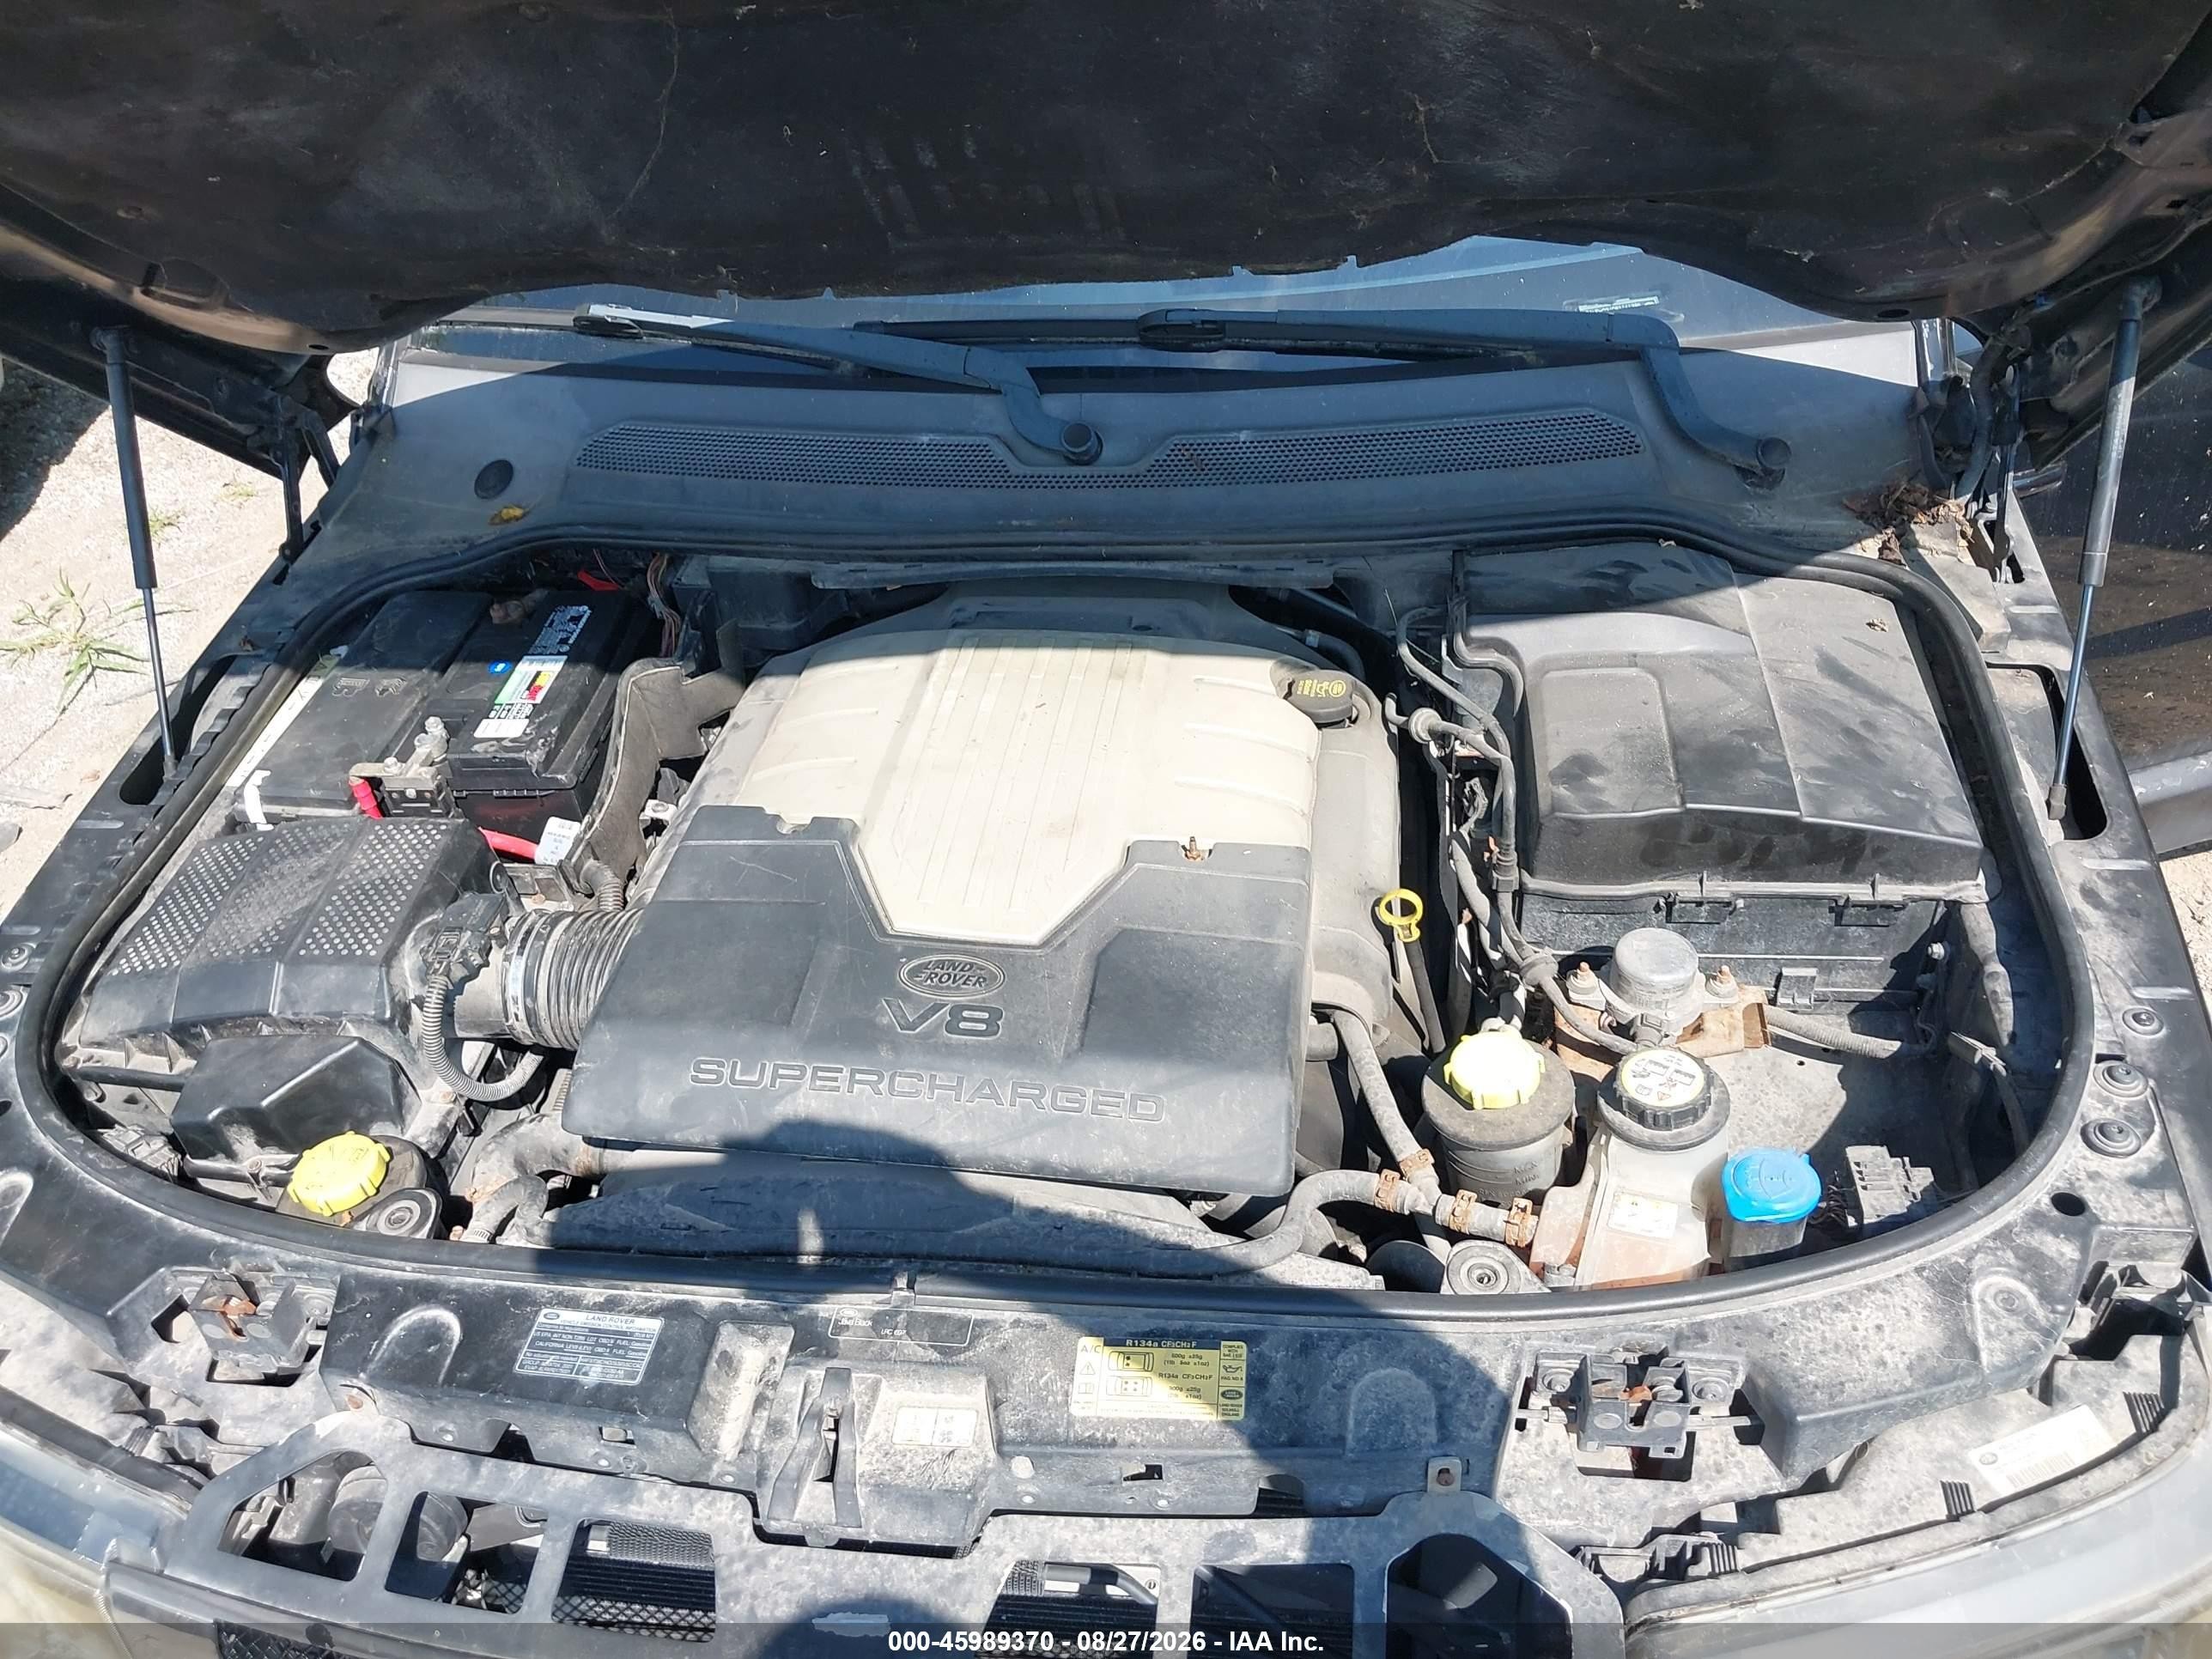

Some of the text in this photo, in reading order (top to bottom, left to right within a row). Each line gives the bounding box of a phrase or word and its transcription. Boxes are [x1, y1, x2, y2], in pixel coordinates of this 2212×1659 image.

[922, 960, 975, 973] LAND
[922, 971, 988, 988] ROVER
[882, 997, 1004, 1040] V8
[690, 1057, 1165, 1122] SUPERCHARGED
[1080, 1345, 1102, 1354] A/C
[1126, 1339, 1158, 1348] R134a
